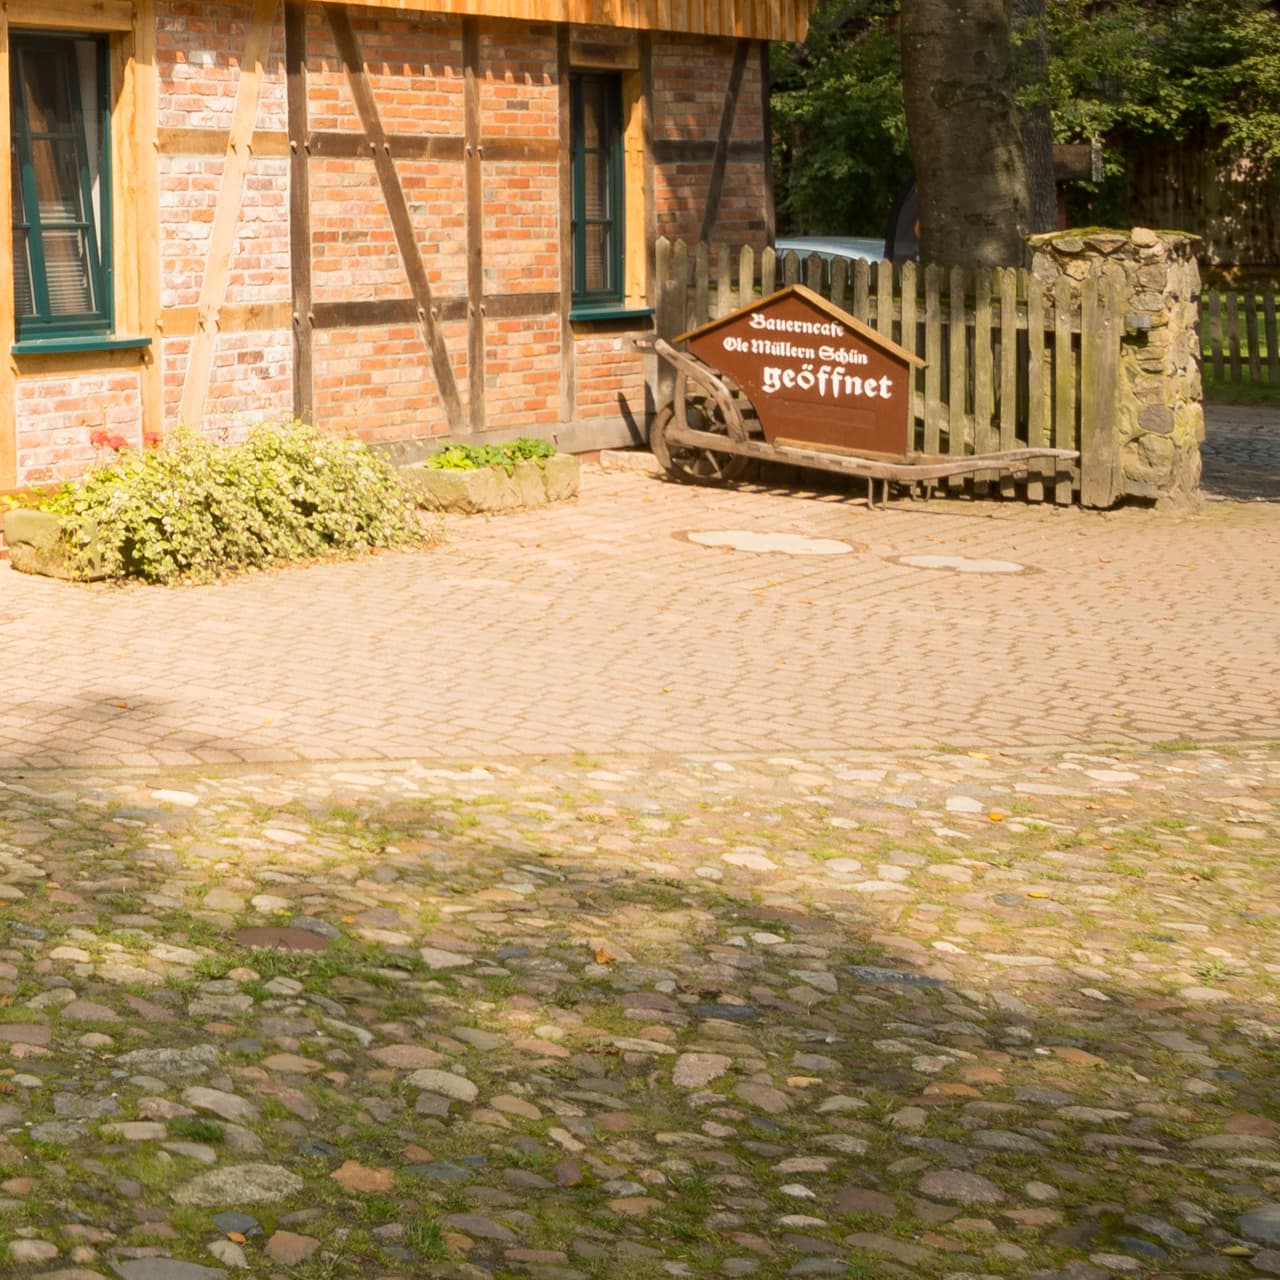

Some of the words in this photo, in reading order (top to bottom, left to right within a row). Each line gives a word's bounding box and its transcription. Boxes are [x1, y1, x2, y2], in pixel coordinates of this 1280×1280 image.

[749, 314, 844, 337] Bauerncafe
[722, 336, 749, 353] Ole
[751, 338, 816, 360] Müllern
[818, 345, 869, 365] Schün
[761, 363, 893, 400] geöffnet
